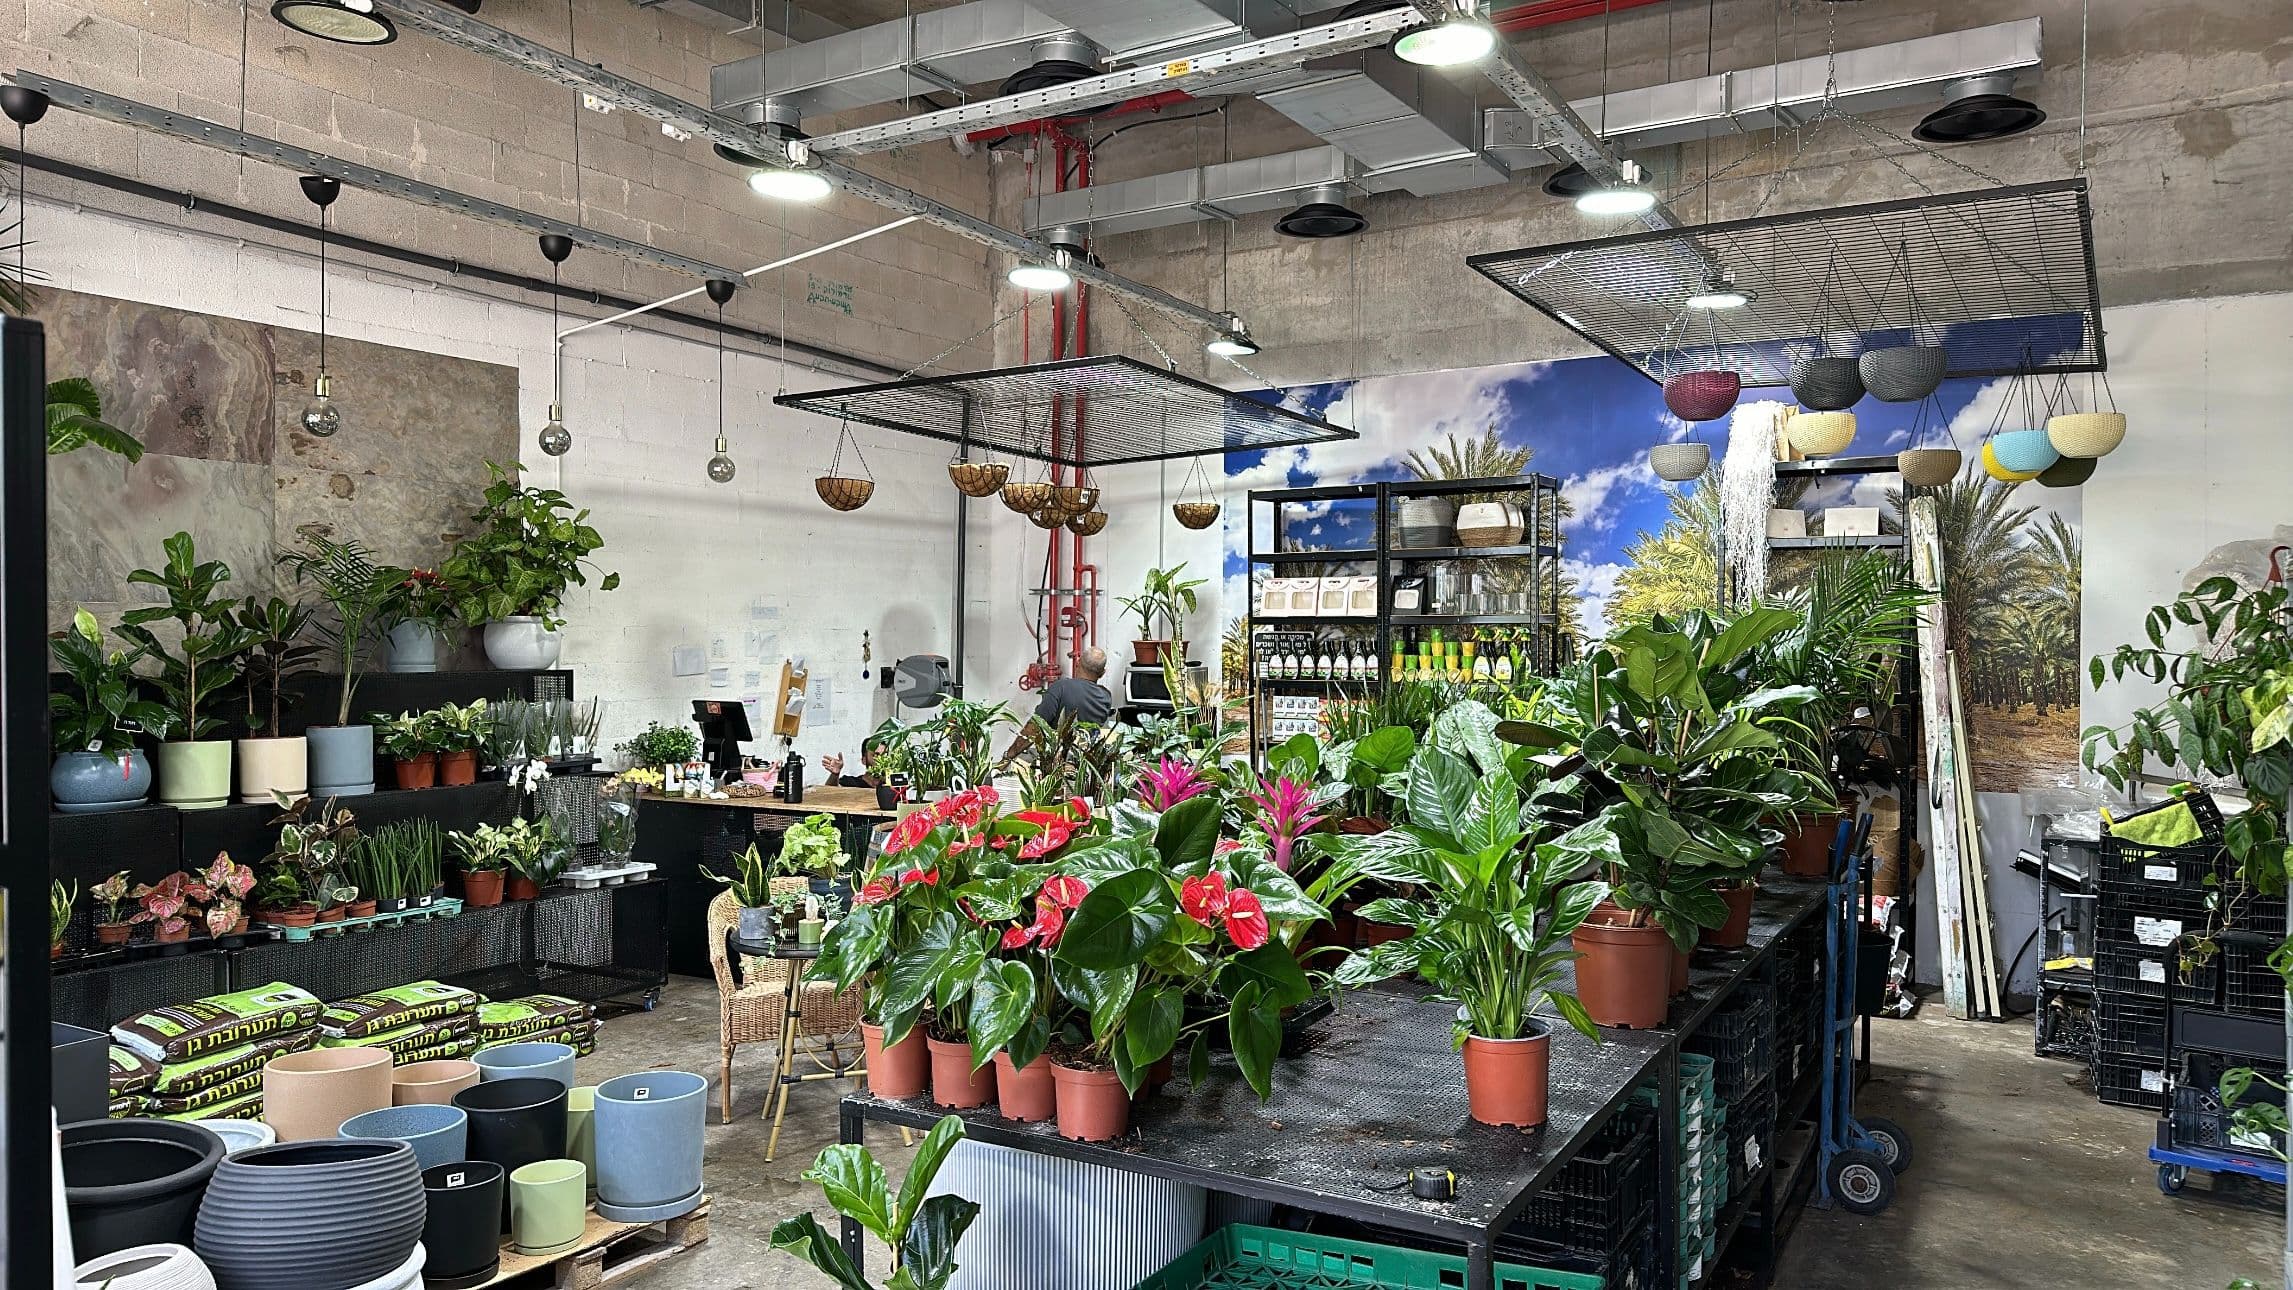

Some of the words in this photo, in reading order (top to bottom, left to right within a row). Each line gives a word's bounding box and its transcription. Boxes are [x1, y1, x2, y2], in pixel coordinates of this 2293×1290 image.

[384, 1004, 443, 1028] תערובת
[207, 1016, 278, 1048] תערובת
[366, 1019, 380, 1035] גן
[187, 1038, 202, 1056] גן
[394, 1046, 441, 1065] תערוב
[207, 1071, 262, 1103] ערובת
[185, 1096, 201, 1111] גן
